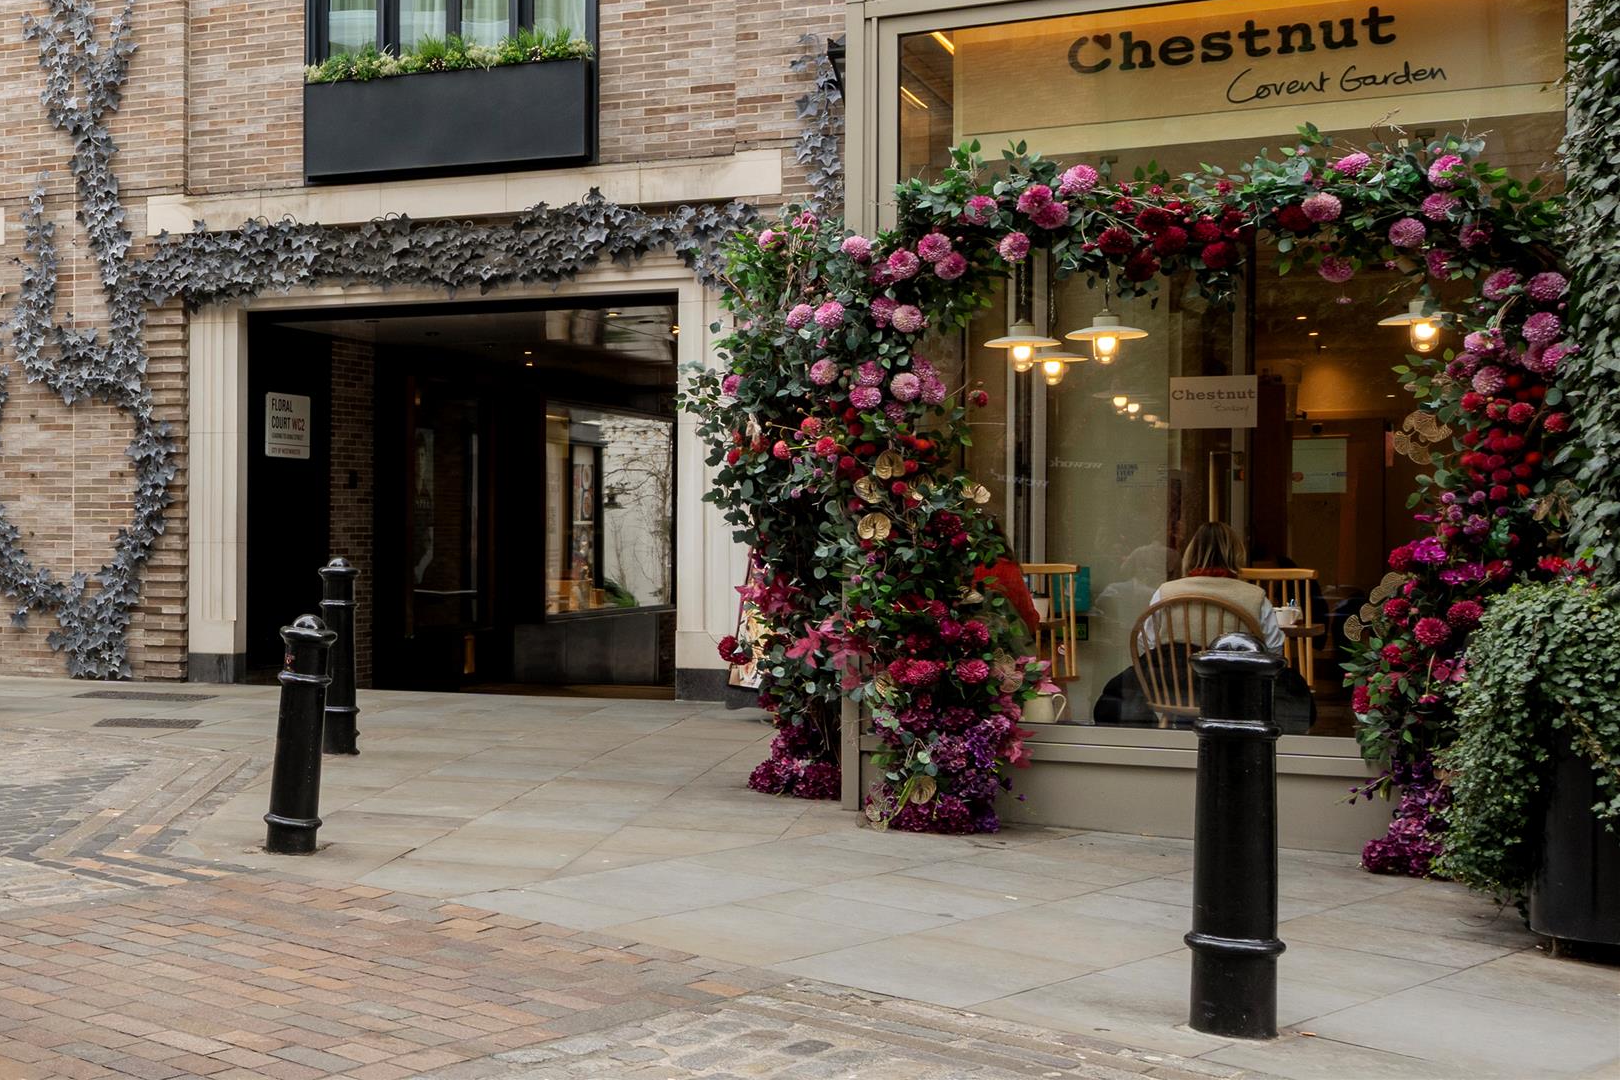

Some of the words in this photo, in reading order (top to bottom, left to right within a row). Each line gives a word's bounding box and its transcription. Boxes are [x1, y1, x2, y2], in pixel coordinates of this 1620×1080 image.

[1067, 6, 1397, 74] Chestnut
[1226, 68, 1329, 104] Covent
[1340, 61, 1447, 92] Garden
[1172, 388, 1256, 401] Chestnut
[271, 398, 293, 412] FLORAL
[271, 415, 290, 430] COURT
[292, 418, 305, 431] WC2
